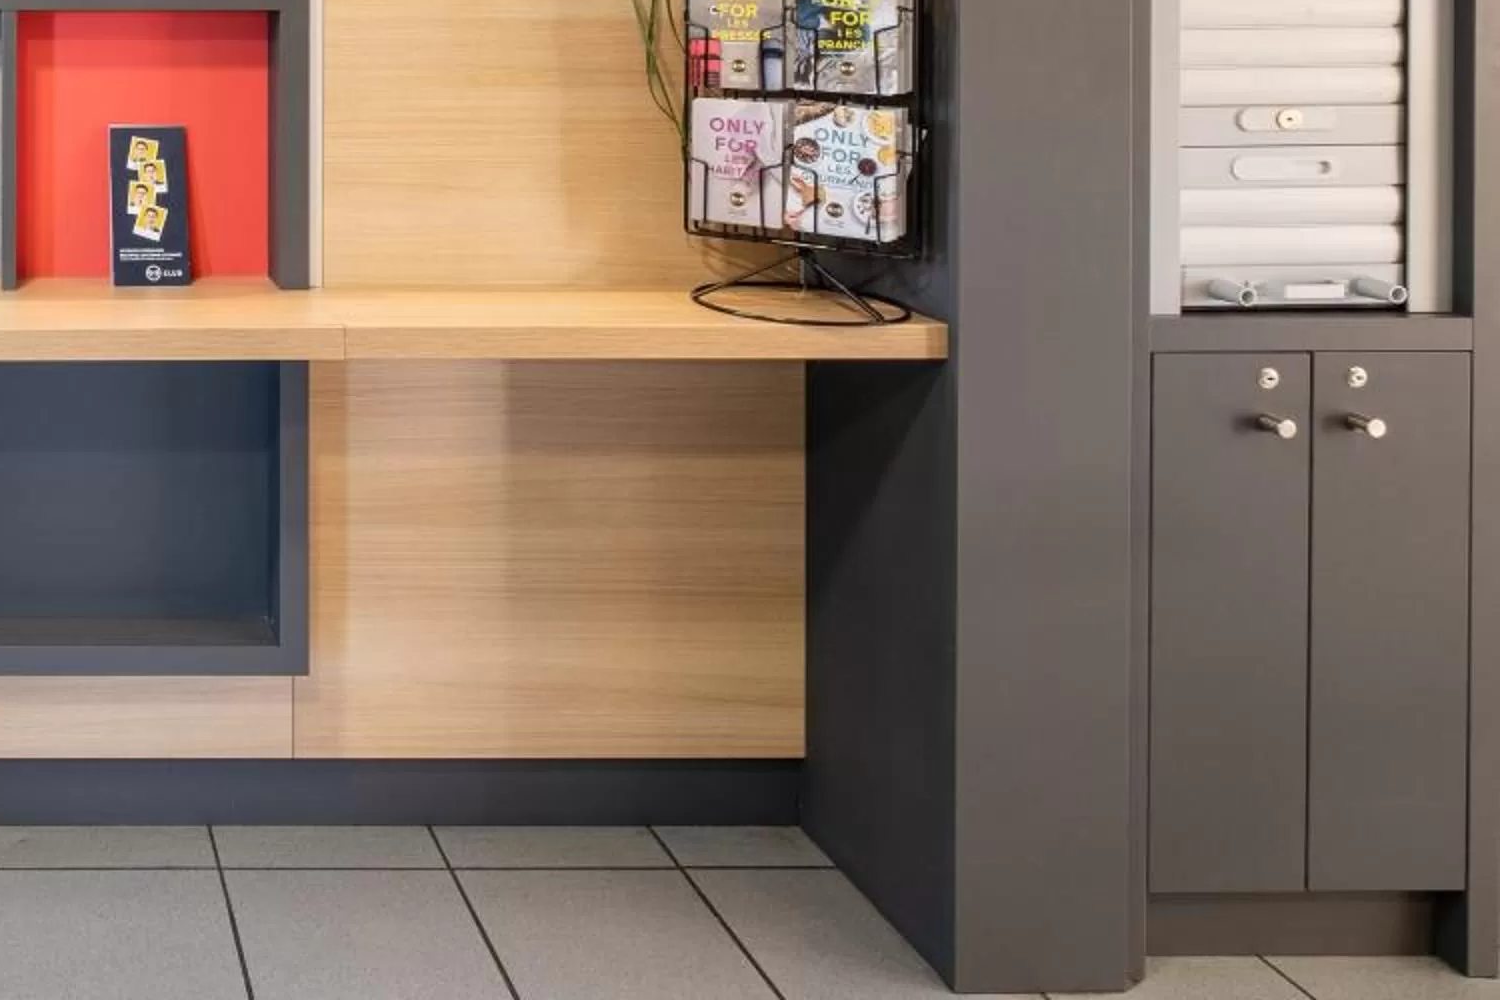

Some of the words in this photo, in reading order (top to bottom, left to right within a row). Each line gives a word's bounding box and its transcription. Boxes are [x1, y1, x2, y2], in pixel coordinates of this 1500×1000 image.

[709, 116, 765, 135] ONLY
[715, 136, 757, 153] FOR
[814, 127, 869, 148] ONLY
[821, 146, 861, 164] FOR
